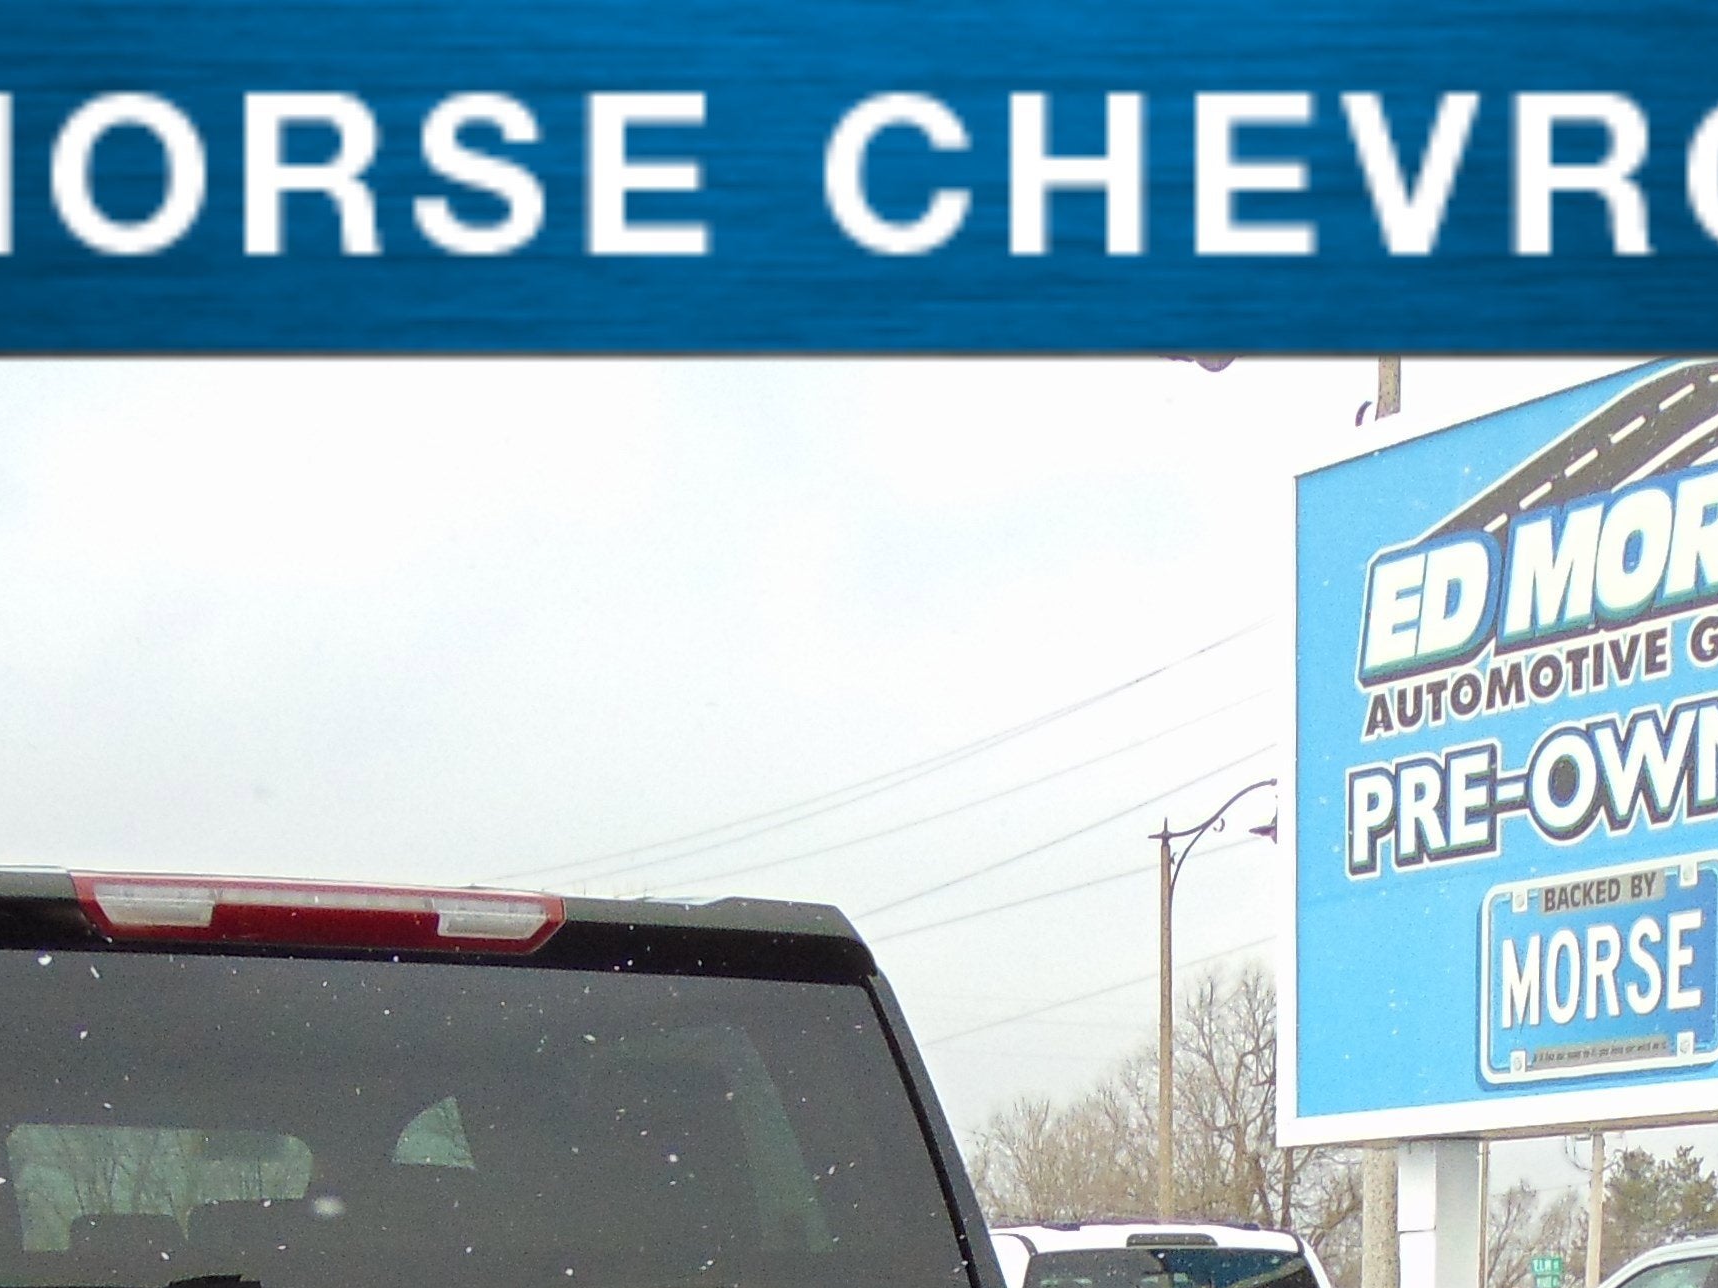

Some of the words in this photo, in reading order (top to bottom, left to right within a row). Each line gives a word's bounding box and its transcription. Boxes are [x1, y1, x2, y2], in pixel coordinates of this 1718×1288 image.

[1362, 537, 1490, 671] ED
[1364, 627, 1668, 737] AUTOMOTIVE
[1543, 879, 1621, 913] BACKED
[1630, 872, 1657, 899] BY
[1501, 910, 1703, 1029] MORSE
